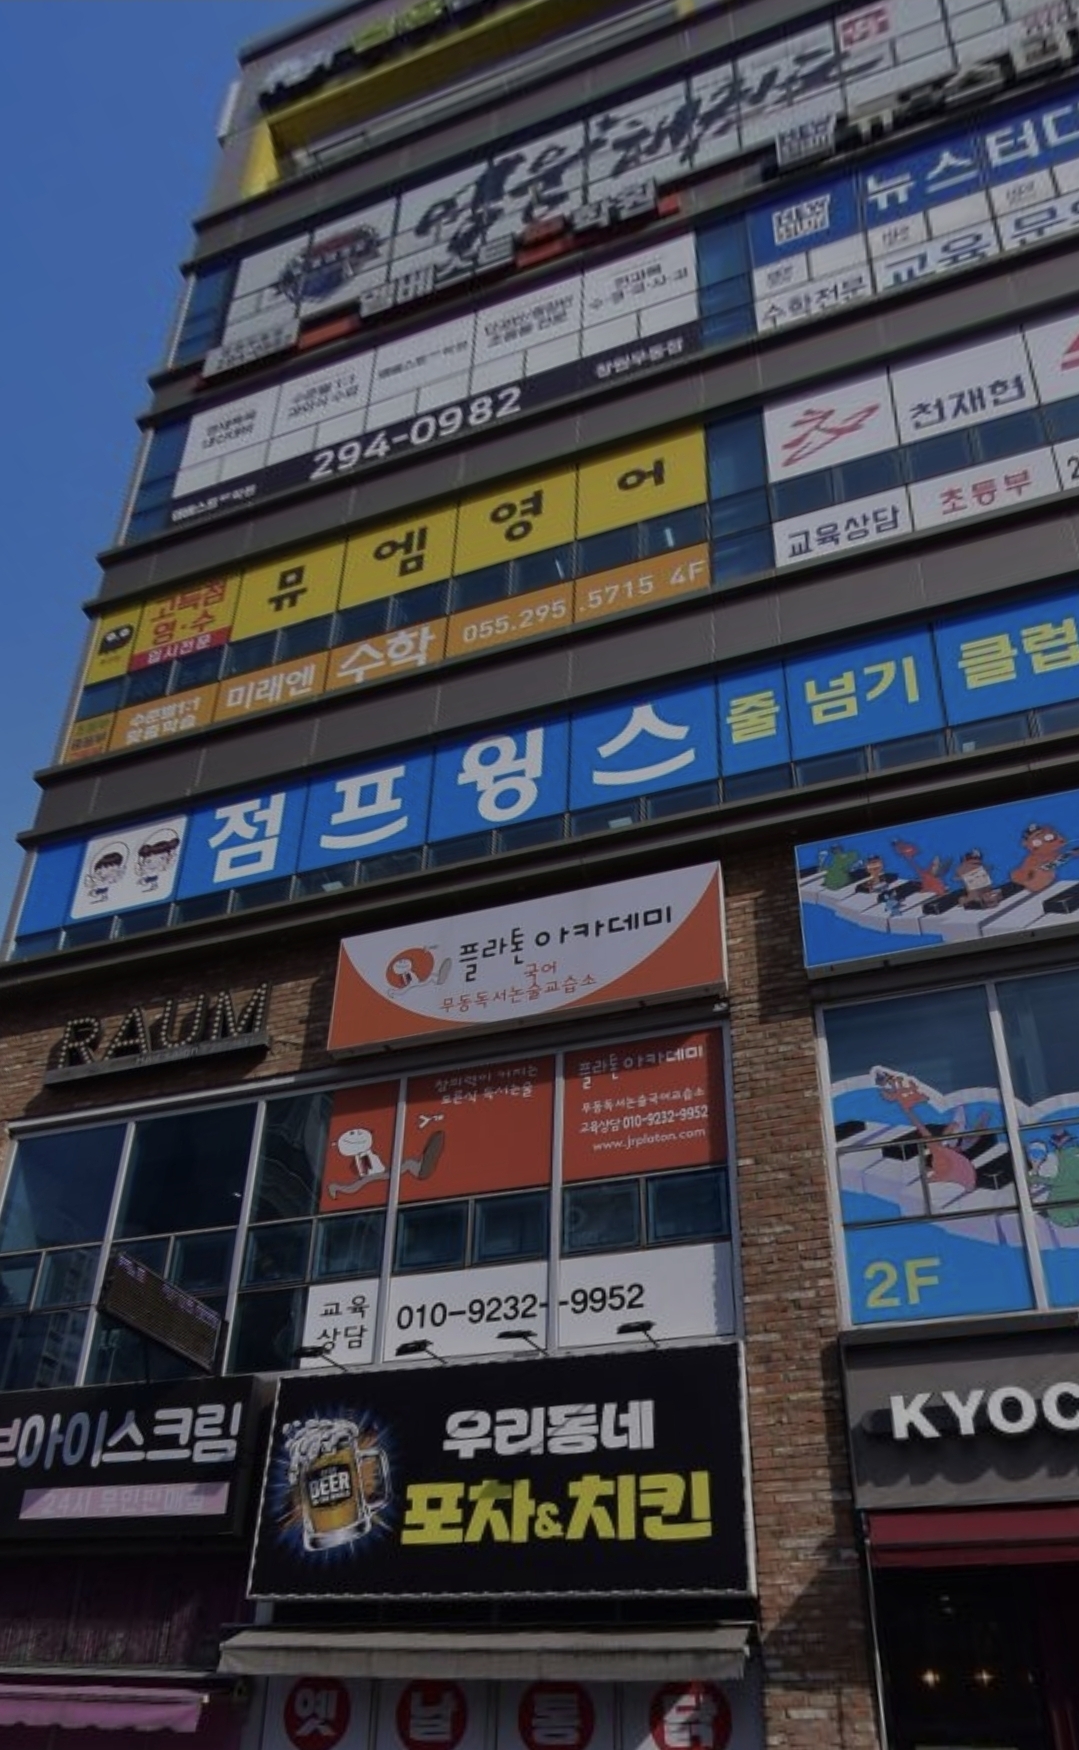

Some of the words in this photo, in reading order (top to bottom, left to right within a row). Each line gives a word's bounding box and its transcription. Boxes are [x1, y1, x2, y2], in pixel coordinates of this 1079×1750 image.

[309, 386, 521, 482] 294-0982
[940, 470, 1032, 516] 초등부
[788, 505, 901, 558] 교육상담
[669, 560, 707, 587] 4F
[226, 663, 315, 710] 미래엔
[337, 626, 437, 684] 수학
[958, 616, 1079, 691] 클럽
[440, 973, 597, 1013] 무동독서논술교습소
[524, 961, 557, 980] 국어
[57, 980, 271, 1070] RAUM
[592, 1127, 707, 1153] www.jrplaton.com
[319, 1294, 371, 1320] 교육
[864, 1256, 942, 1309] 2F
[317, 1324, 369, 1353] 상담
[442, 1398, 656, 1461] 우리동네
[889, 1381, 1079, 1441] KYOC
[308, 1470, 352, 1503] BEER
[400, 1469, 713, 1547] 포차&치킨
